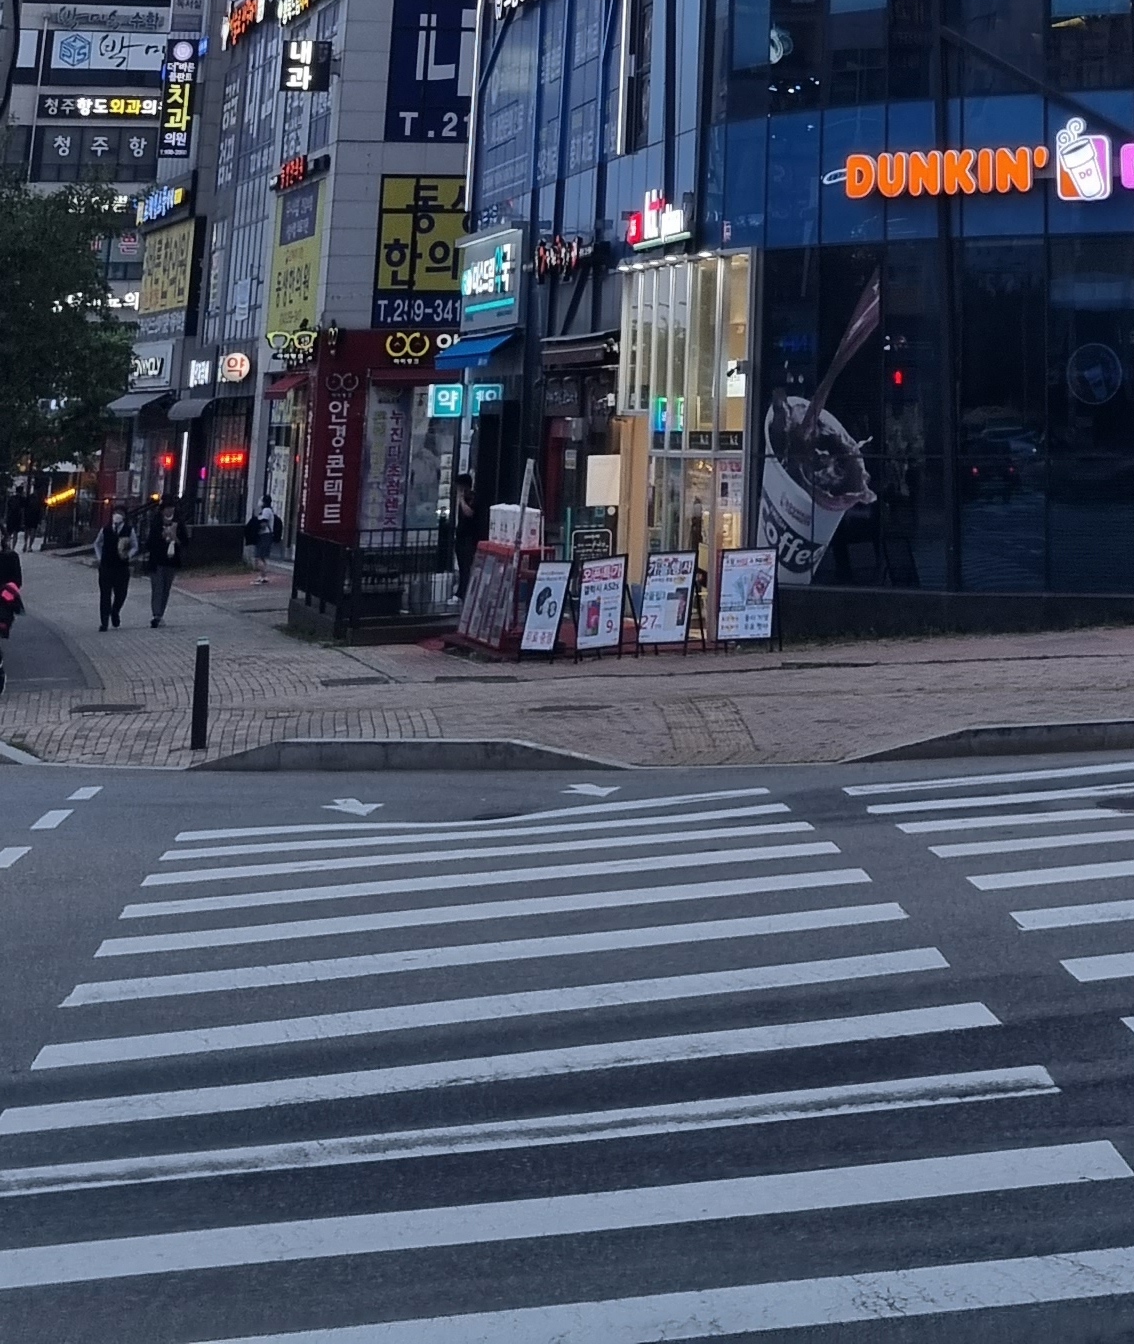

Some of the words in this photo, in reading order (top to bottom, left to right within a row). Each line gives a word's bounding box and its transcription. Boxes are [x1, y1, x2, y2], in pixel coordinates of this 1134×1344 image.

[286, 41, 312, 90] 내과
[164, 83, 191, 131] 치과
[845, 146, 1048, 199] DUNKIN'
[437, 389, 459, 411] 약
